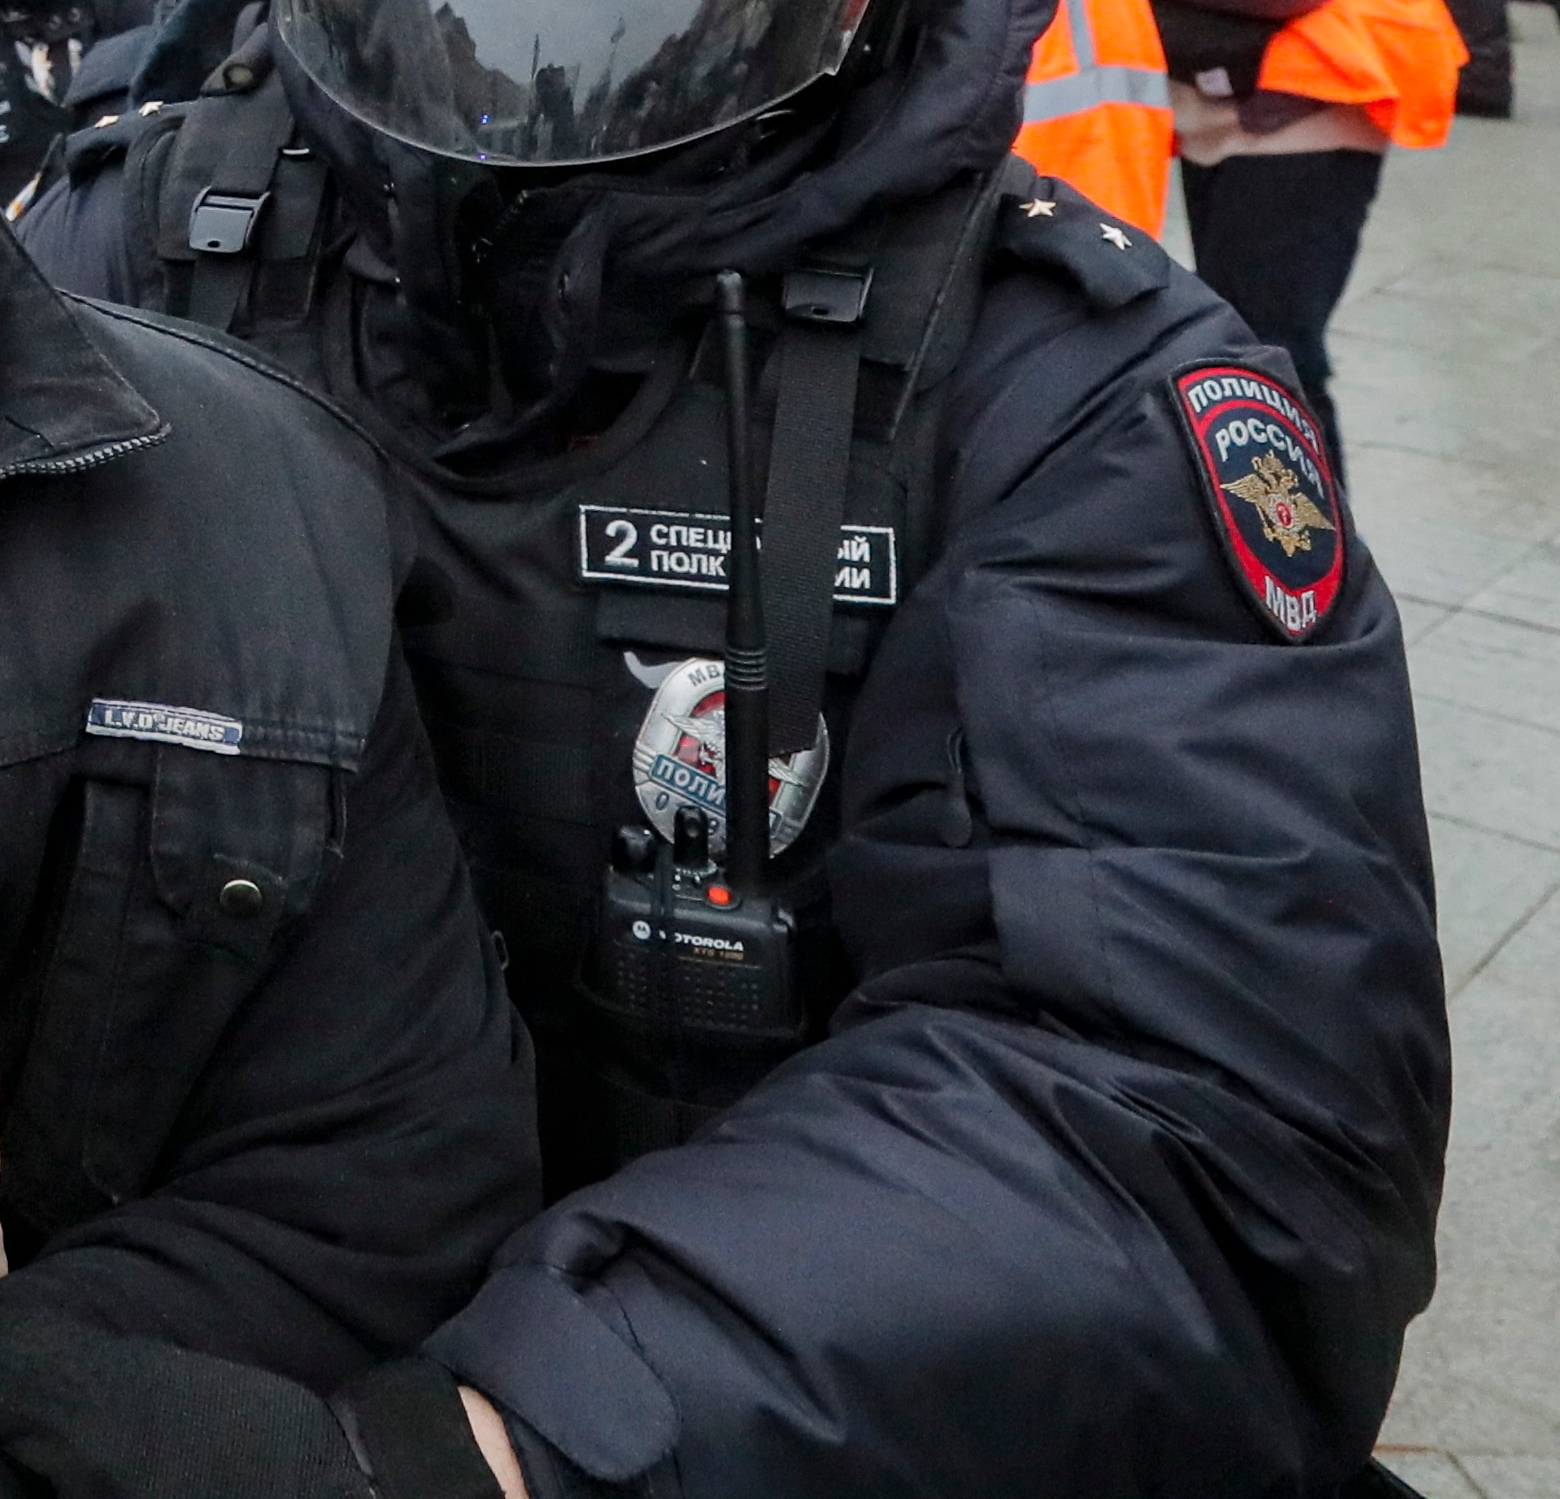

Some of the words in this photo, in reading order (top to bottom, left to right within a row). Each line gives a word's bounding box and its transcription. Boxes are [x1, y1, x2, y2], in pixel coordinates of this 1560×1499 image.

[1188, 377, 1320, 454] ПОЛИЦИЯ
[1215, 417, 1325, 500] РОССИЯ
[604, 519, 640, 568] 2
[650, 550, 726, 577] ПОЛК
[1264, 575, 1318, 632] МВД
[161, 716, 225, 741] JEANS
